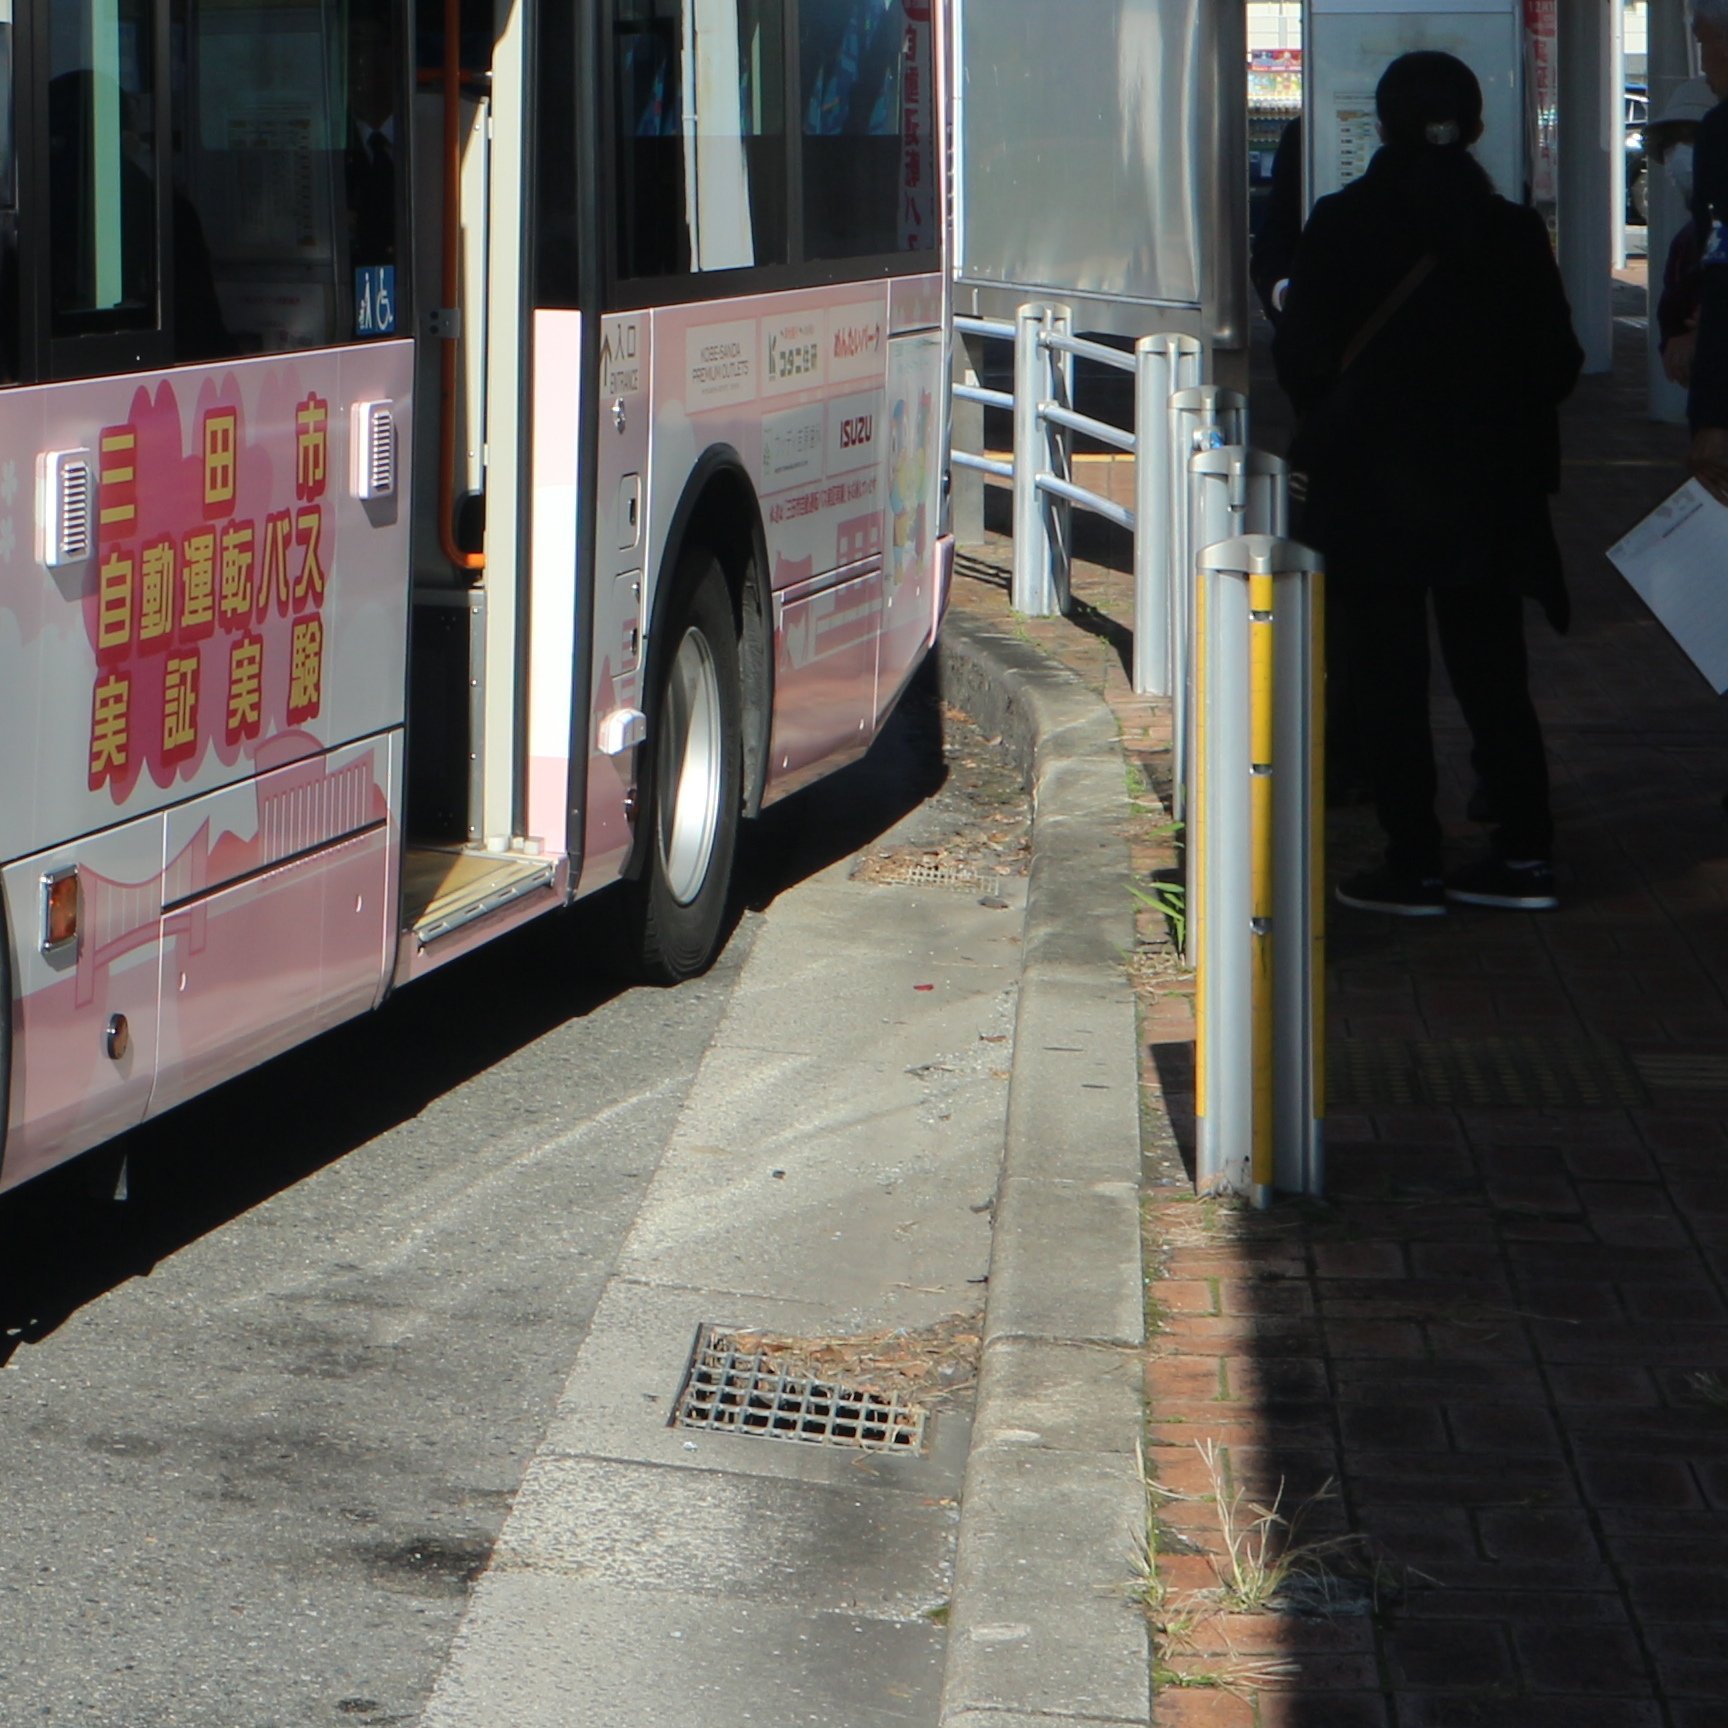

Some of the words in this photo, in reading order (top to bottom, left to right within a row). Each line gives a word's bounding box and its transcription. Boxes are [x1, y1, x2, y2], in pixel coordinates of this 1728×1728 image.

[615, 323, 637, 360] 入口
[100, 394, 329, 534] 三田市
[840, 415, 873, 449] ISUZU
[97, 512, 327, 654] 自動運転バス
[89, 617, 325, 779] 実証実験
